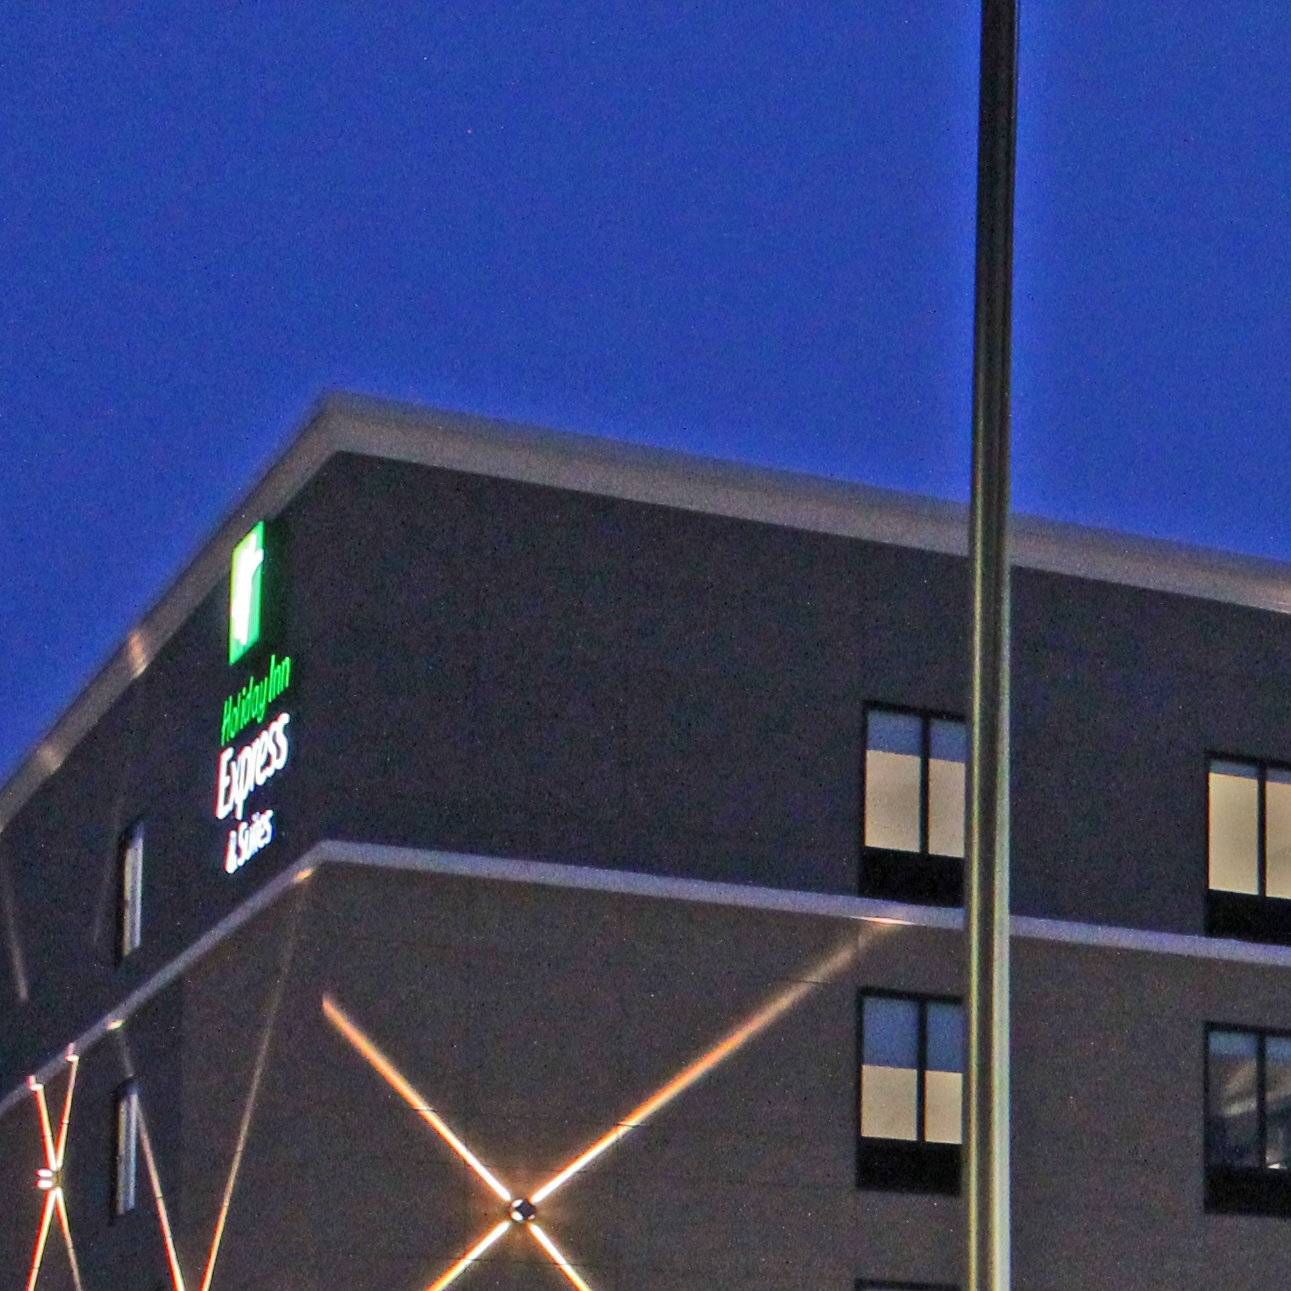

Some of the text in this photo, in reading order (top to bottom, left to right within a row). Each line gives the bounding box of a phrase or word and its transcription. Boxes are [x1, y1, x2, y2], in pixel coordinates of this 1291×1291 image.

[221, 654, 292, 746] Holiday Inn
[215, 712, 291, 820] Express
[238, 809, 274, 866] Suites
